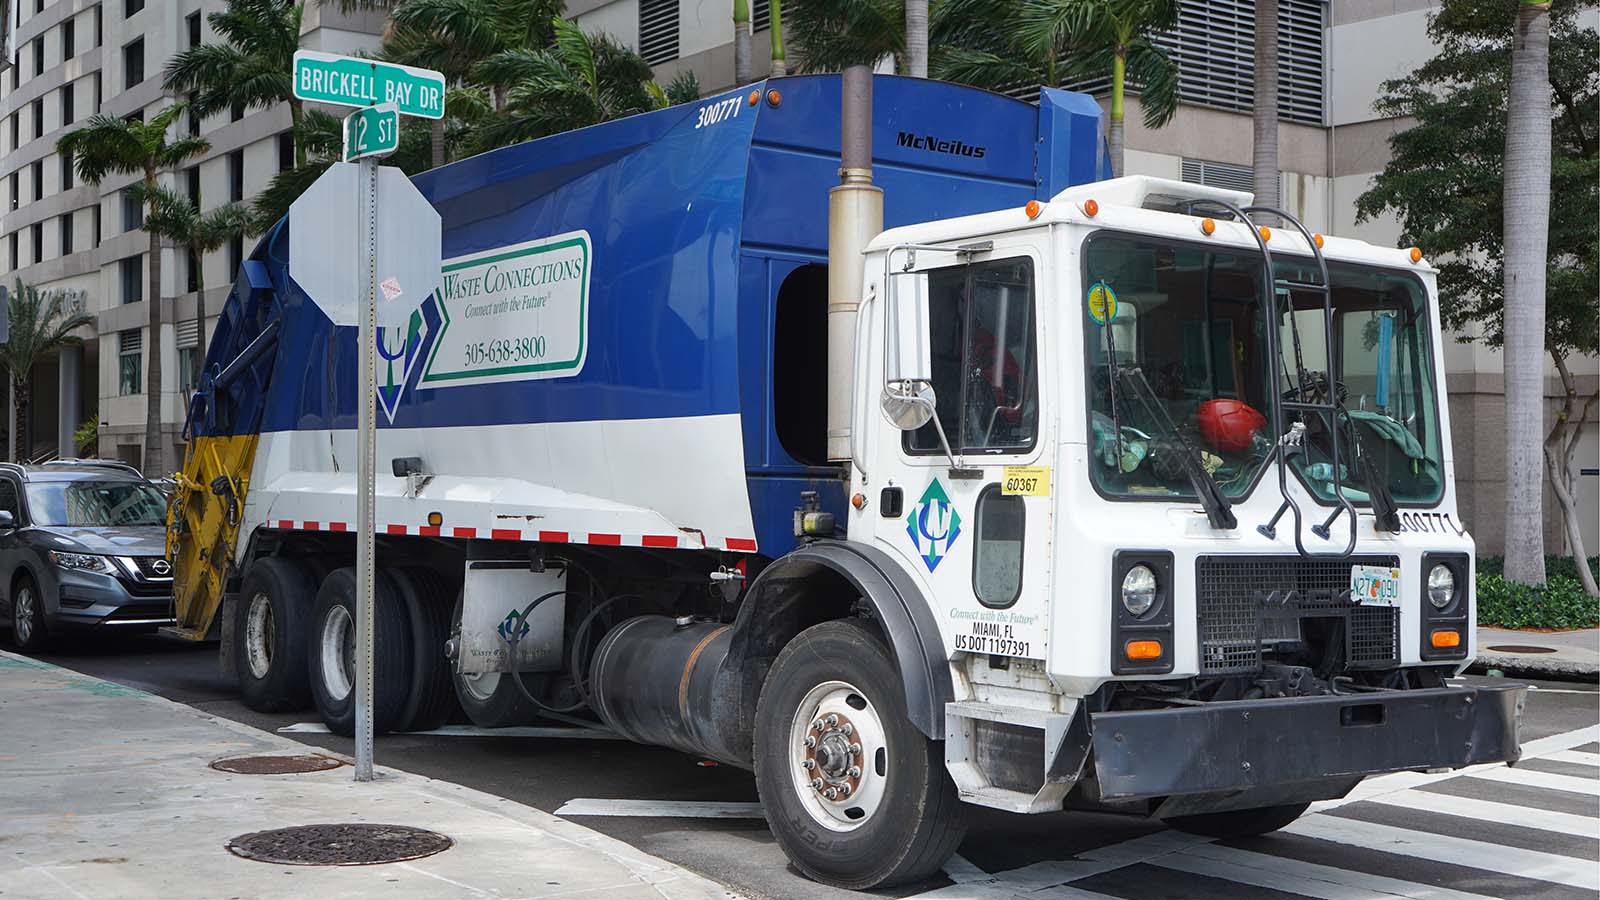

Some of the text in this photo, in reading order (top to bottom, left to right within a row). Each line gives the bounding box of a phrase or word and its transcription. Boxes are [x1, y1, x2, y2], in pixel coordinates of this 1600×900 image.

[301, 67, 439, 110] BRICKELL BAY DR
[695, 96, 743, 129] 300771
[354, 116, 393, 153] 12 ST
[897, 131, 986, 158] McNeilus
[443, 257, 582, 300] WASTE CONNECTIONS
[465, 302, 491, 319] Connect
[491, 299, 509, 315] with
[509, 297, 521, 312] the
[464, 335, 546, 367] 305-638-3800
[1007, 478, 1038, 492] 60367
[950, 607, 979, 620] Connect
[980, 611, 996, 622] with
[997, 611, 1009, 623] the
[973, 621, 1014, 639] MIAMI, FL
[955, 633, 1030, 657] US DOT 1197391
